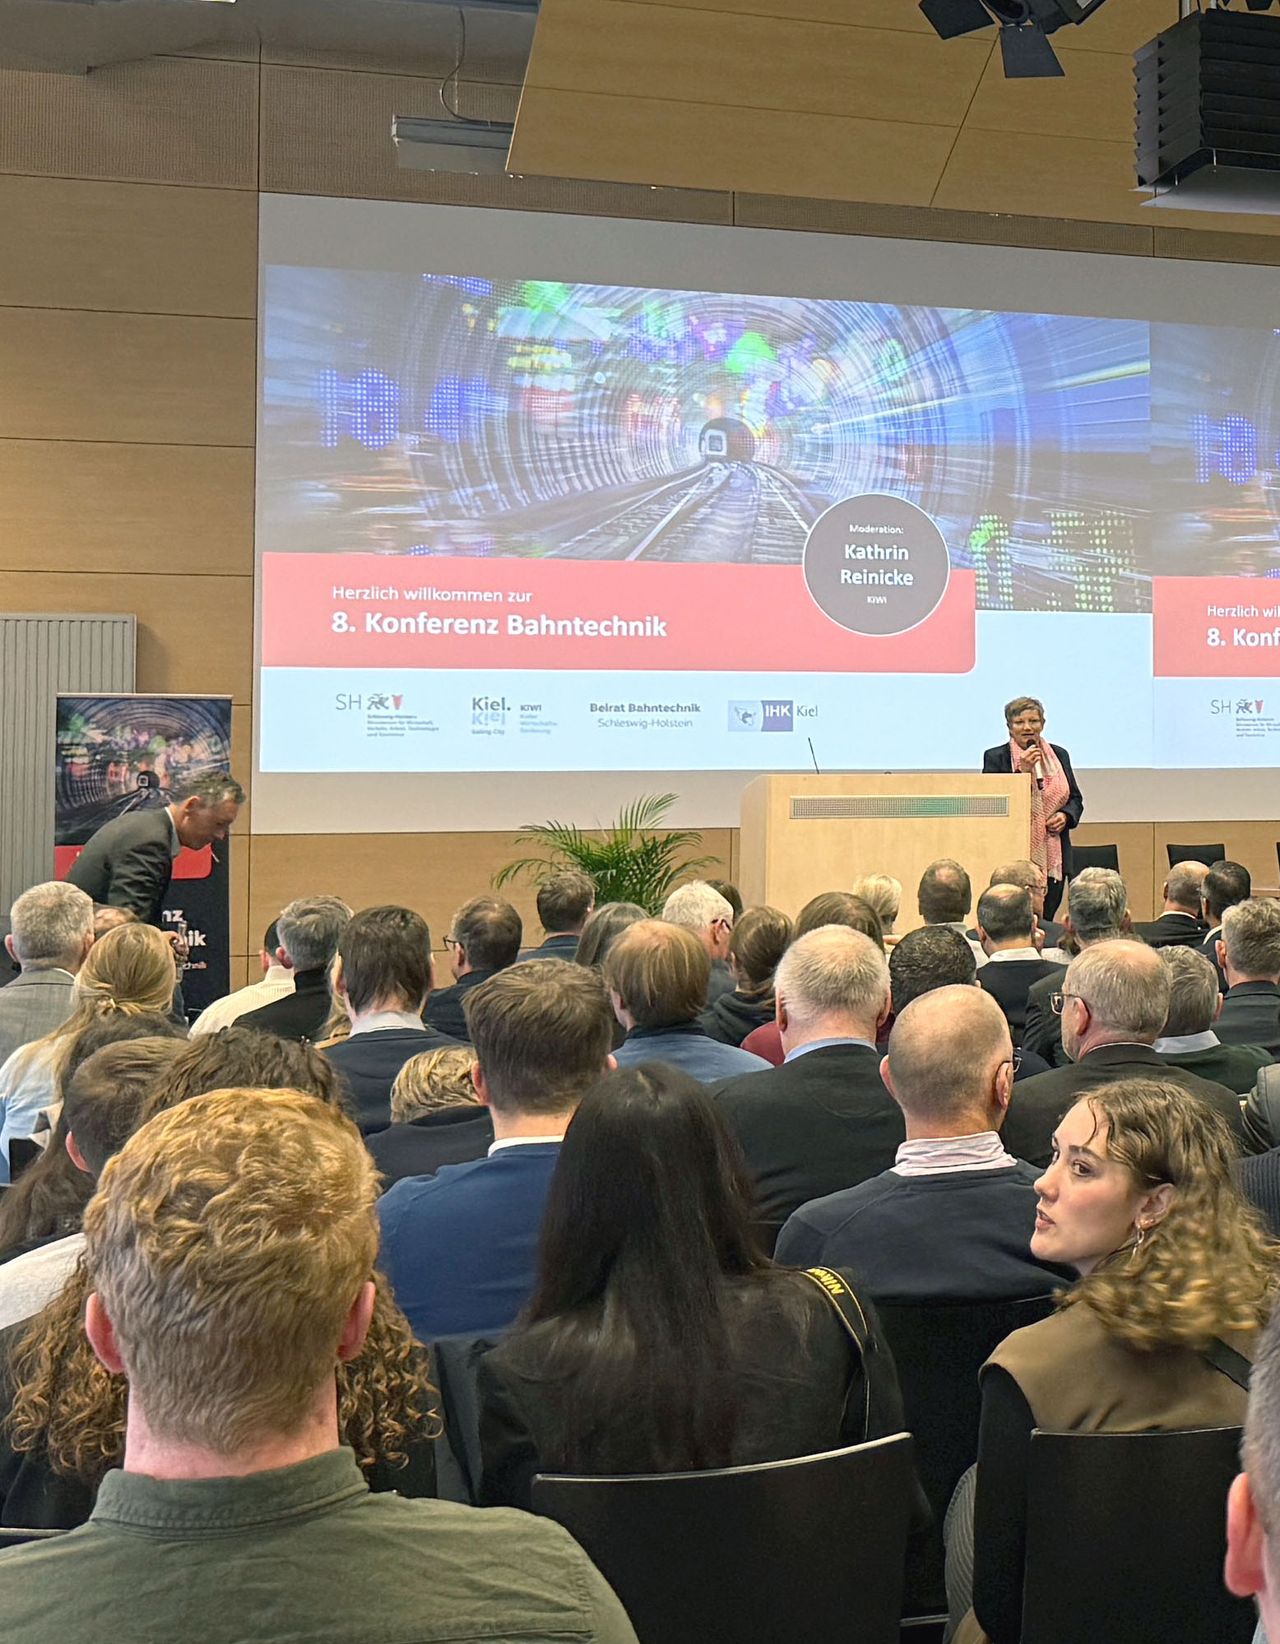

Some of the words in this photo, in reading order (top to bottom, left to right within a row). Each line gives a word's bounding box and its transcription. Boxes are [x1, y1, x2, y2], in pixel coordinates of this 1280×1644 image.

[849, 525, 904, 534] Moderation:
[845, 544, 908, 560] Kathrin
[841, 569, 914, 586] Reinicke
[333, 585, 398, 600] Herzlich
[404, 587, 503, 602] willkommen
[508, 591, 533, 602] zur
[1208, 605, 1258, 617] Herzlich
[331, 612, 356, 632] 8.
[366, 612, 499, 635] Konferenz
[507, 614, 667, 637] Bahntechnik
[1207, 628, 1226, 646] 8.
[336, 693, 362, 710] SH
[472, 697, 512, 711] Kiel.
[590, 703, 625, 713] Beirat
[628, 703, 701, 713] Bahntechnik
[1211, 700, 1232, 714] SH
[765, 704, 792, 718] IHK
[797, 705, 818, 718] Kiel
[598, 718, 693, 729] Schleswig-Holstein
